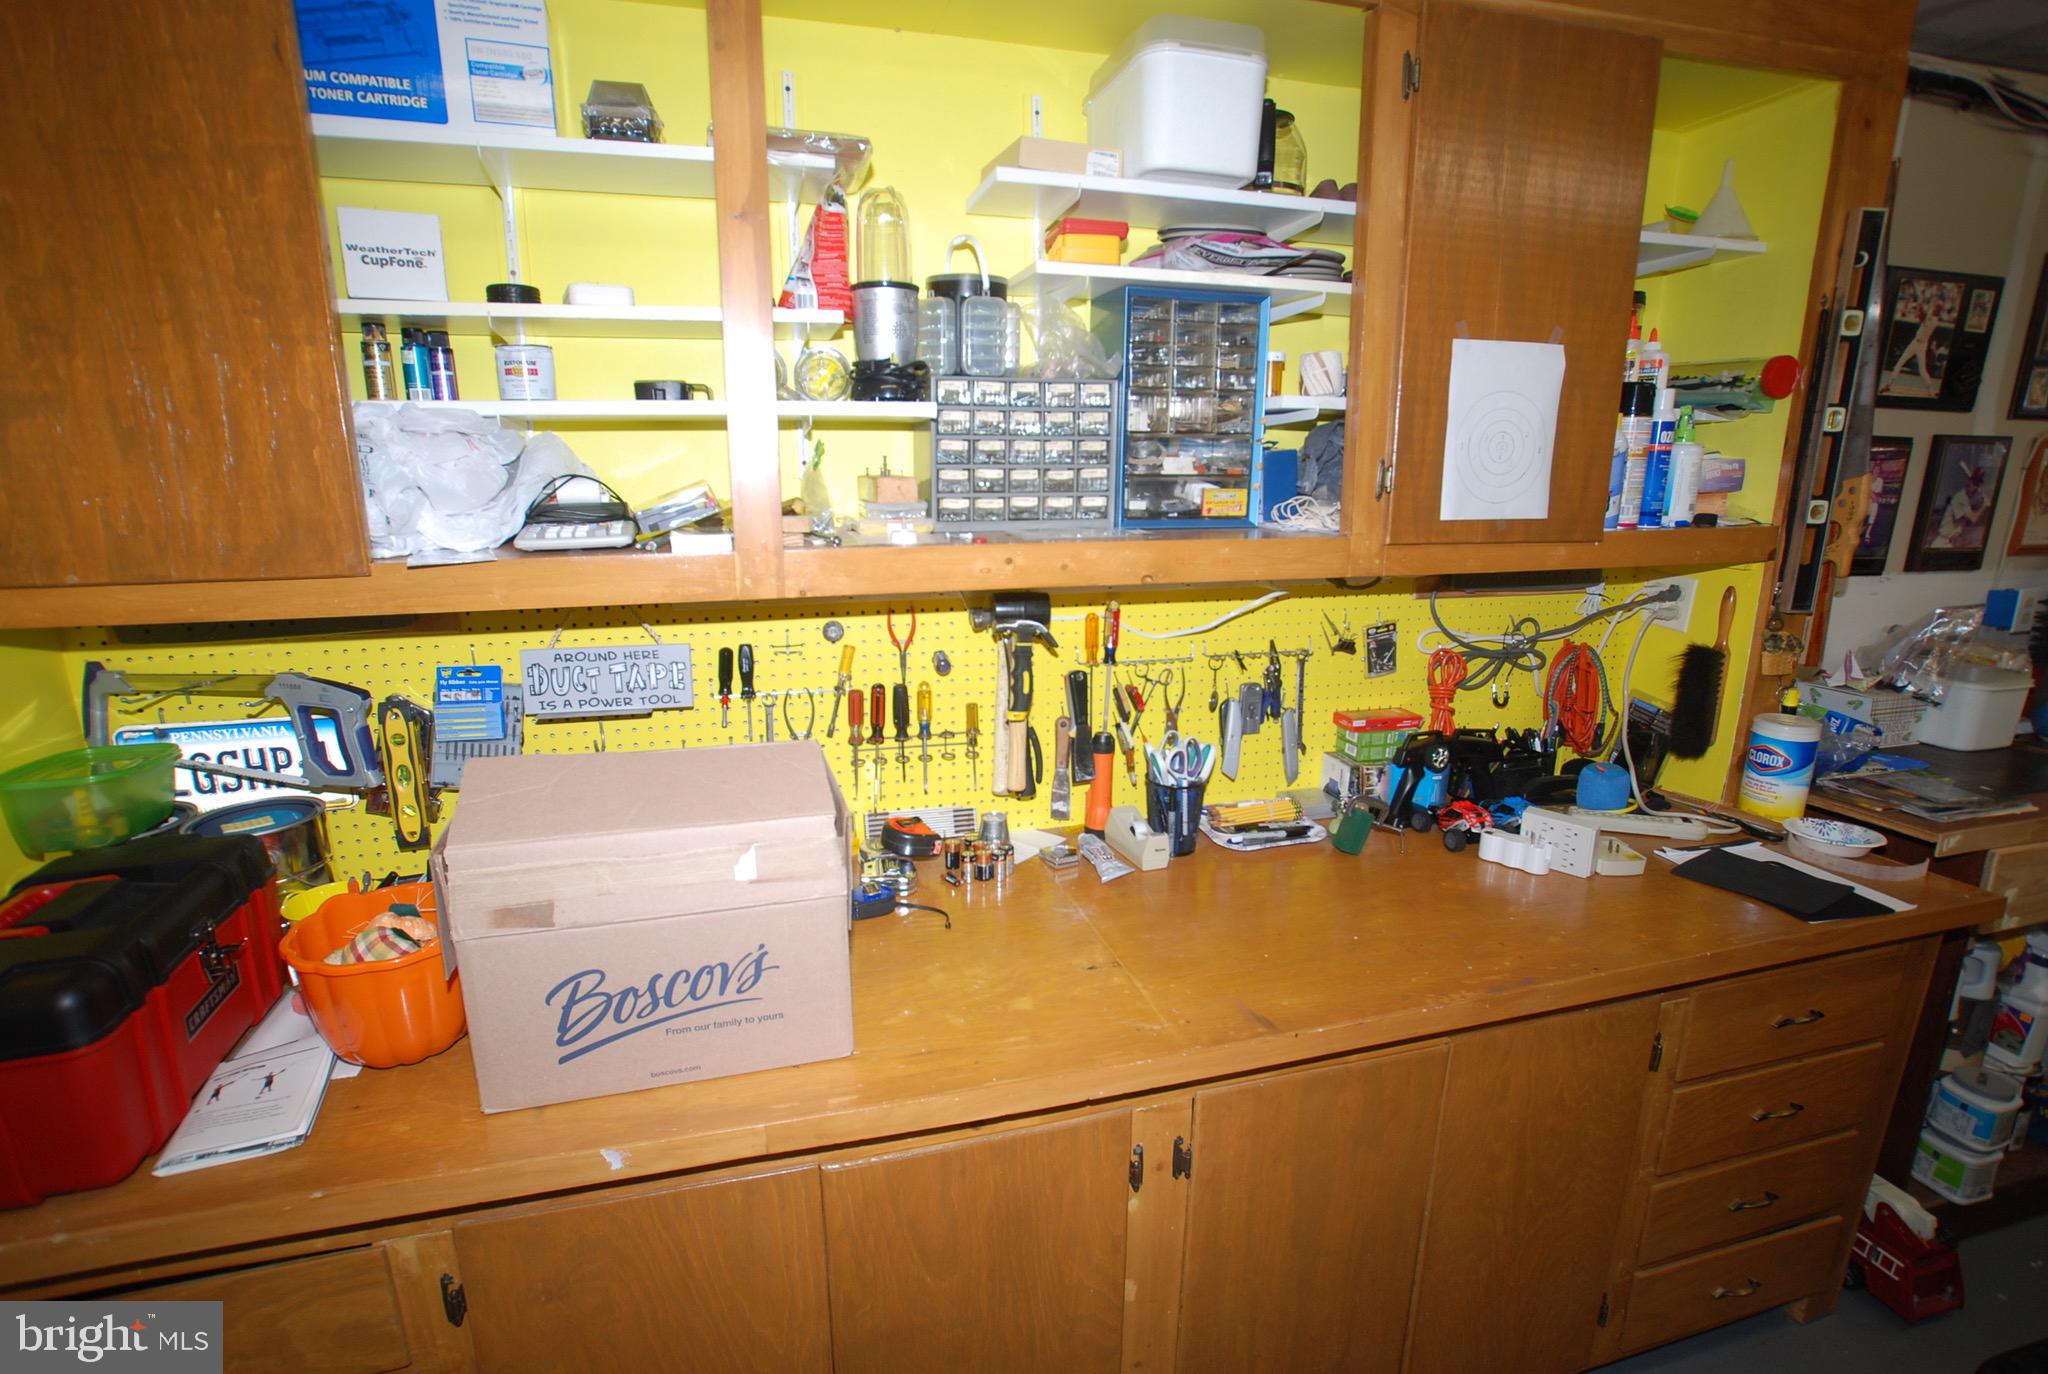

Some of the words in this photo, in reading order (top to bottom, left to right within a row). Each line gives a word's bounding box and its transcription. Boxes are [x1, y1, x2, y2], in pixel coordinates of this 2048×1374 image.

[330, 72, 411, 91] COMPATIBLE
[310, 86, 353, 102] TONER
[357, 91, 428, 109] CARTRIDGE
[345, 243, 436, 257] WeatherTech
[361, 254, 425, 269] CupFone
[553, 651, 617, 663] AROUND
[623, 650, 660, 661] HERE
[527, 662, 601, 697] DUCT
[609, 661, 687, 694] TAPE
[538, 701, 557, 711] IS
[563, 699, 573, 709] A
[579, 697, 633, 708] POWER
[639, 694, 681, 706] TOOL
[169, 725, 290, 742] PENNSYLVANIA
[1748, 748, 1785, 768] CLOROX
[545, 943, 780, 1048] Boscov's
[665, 1026, 692, 1037] From
[693, 1022, 711, 1032] our
[713, 1016, 743, 1031] family
[744, 1015, 755, 1025] to
[756, 1012, 785, 1024] yours
[650, 1064, 702, 1079] boscovs.com
